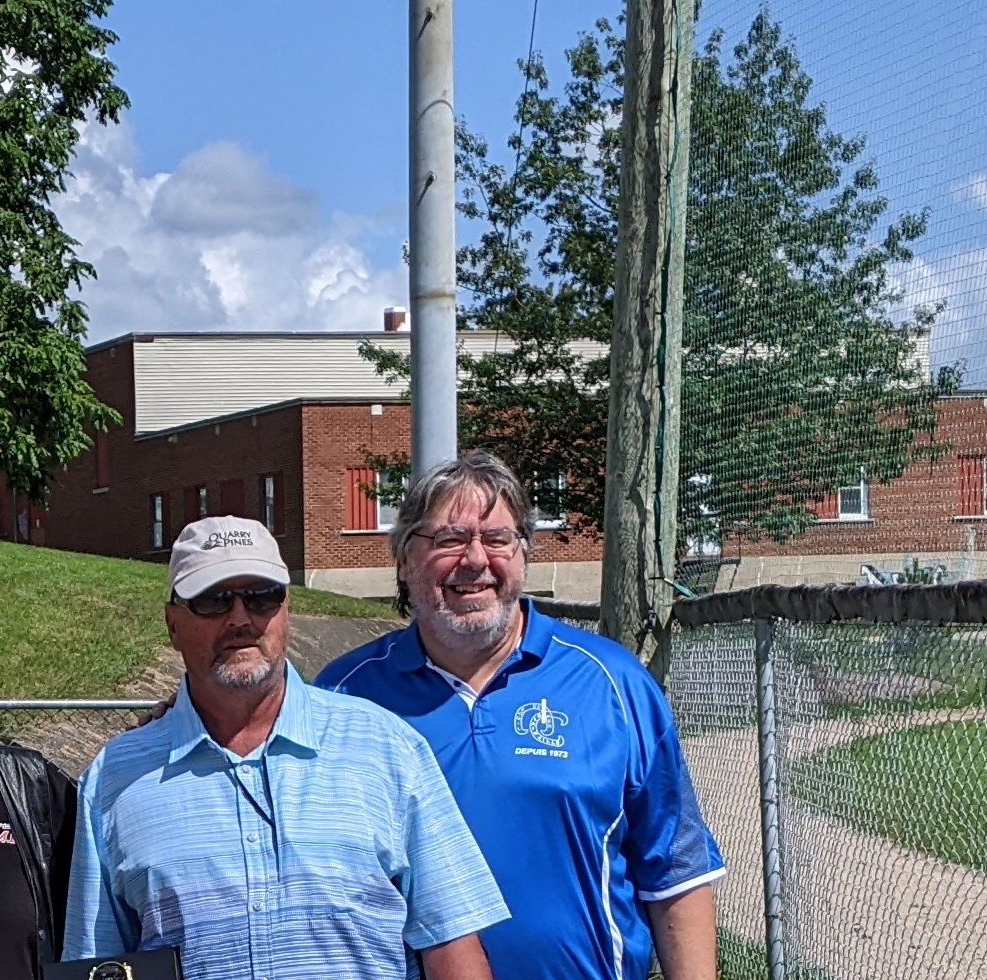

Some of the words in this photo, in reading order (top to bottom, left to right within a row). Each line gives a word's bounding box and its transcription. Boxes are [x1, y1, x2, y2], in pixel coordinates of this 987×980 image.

[209, 530, 251, 543] QUARRY
[224, 538, 254, 547] PINES
[515, 747, 547, 756] DEPUIS
[549, 749, 569, 759] 1973
